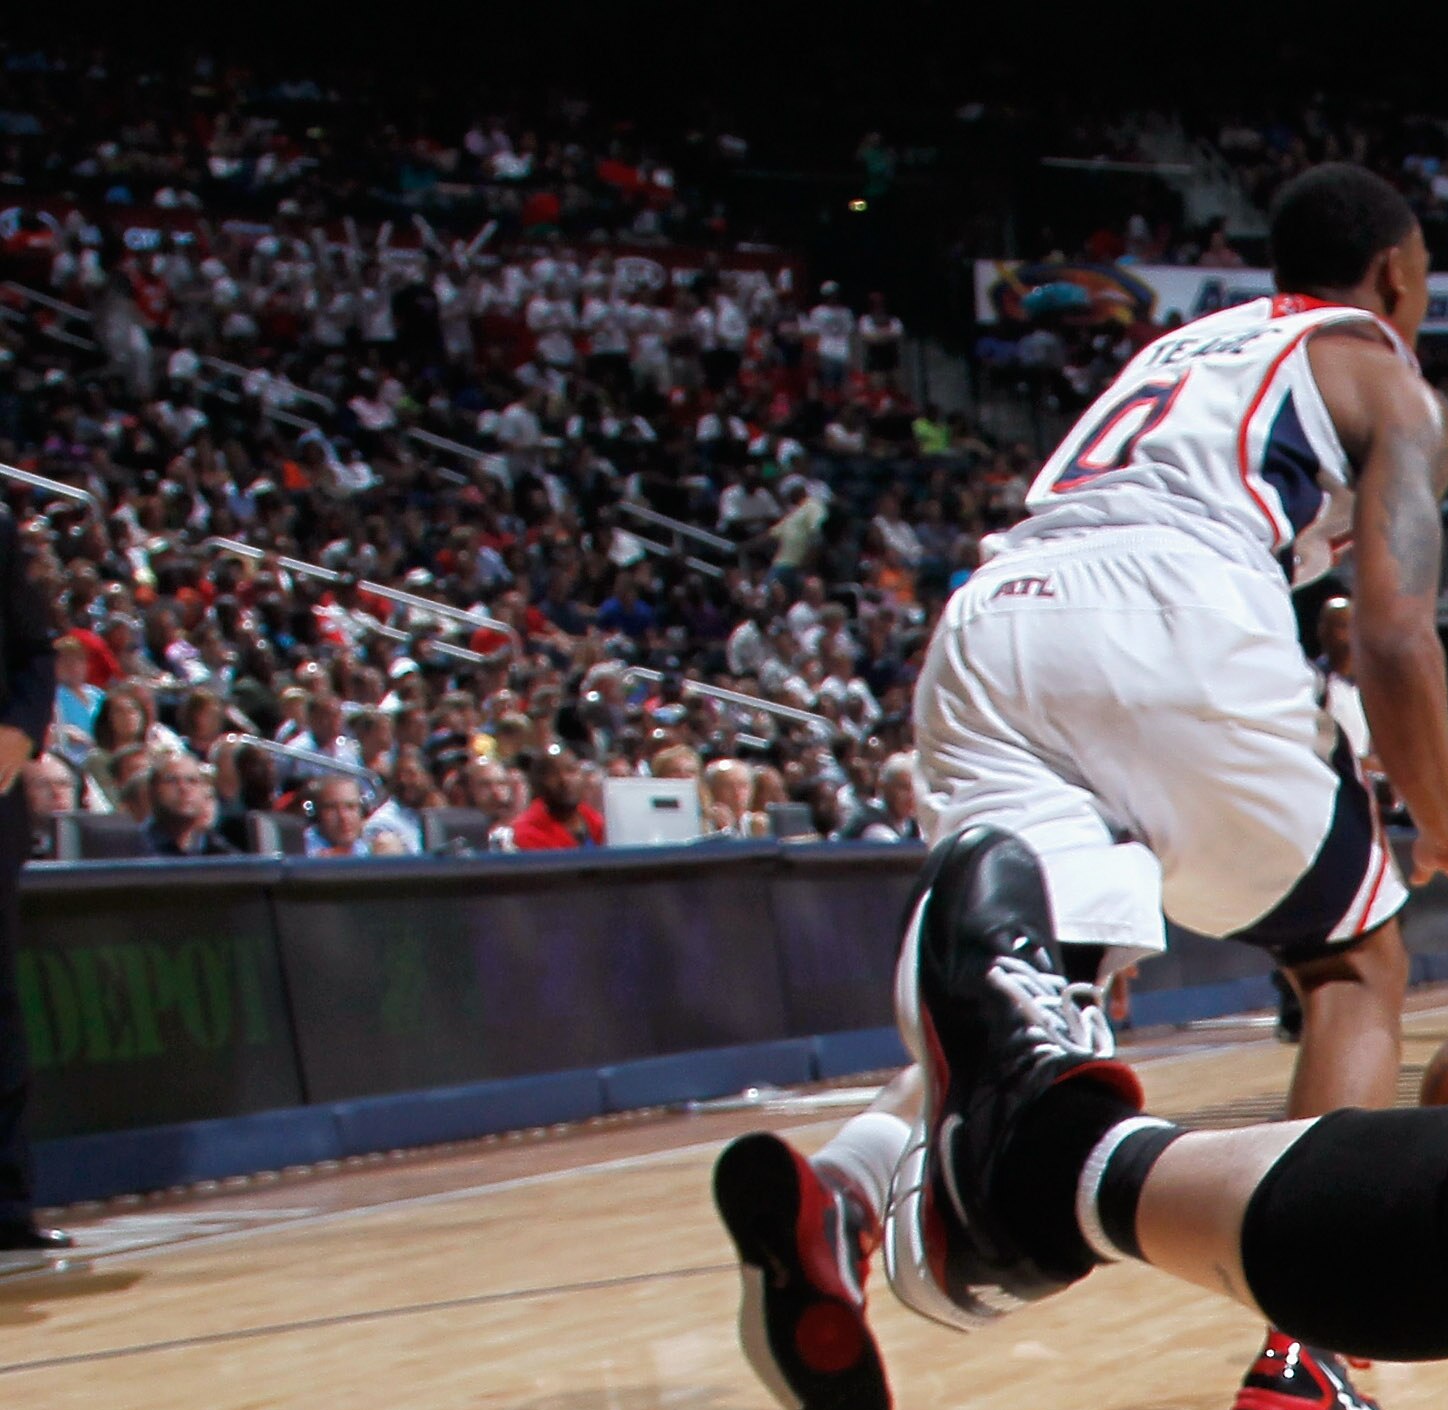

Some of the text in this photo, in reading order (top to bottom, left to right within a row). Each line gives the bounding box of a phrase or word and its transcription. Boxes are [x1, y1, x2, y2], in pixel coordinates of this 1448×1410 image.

[1052, 366, 1192, 493] 0
[991, 575, 1055, 600] ATL
[14, 936, 268, 1068] DEPOT
